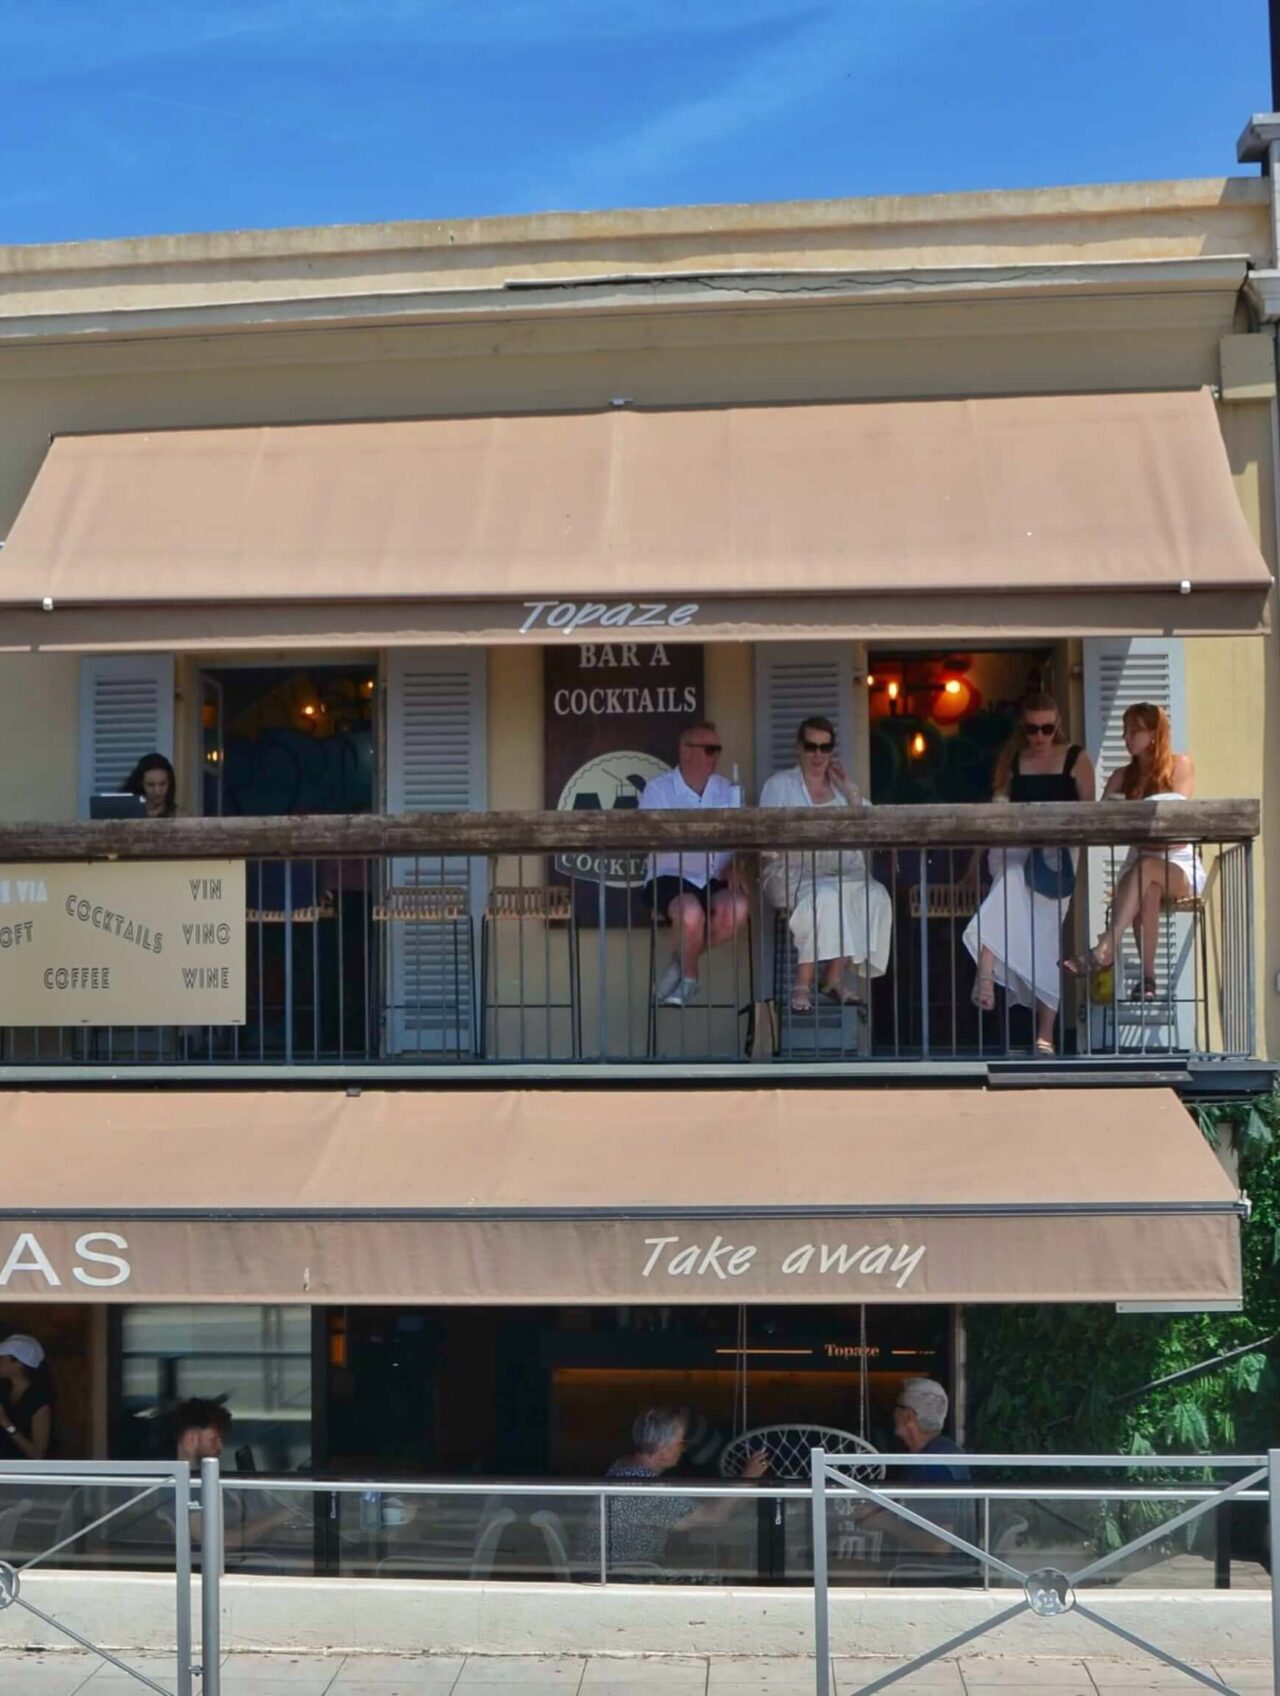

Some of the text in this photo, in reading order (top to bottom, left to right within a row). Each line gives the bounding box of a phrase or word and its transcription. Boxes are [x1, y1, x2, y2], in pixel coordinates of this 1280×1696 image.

[519, 600, 699, 634] Topaze
[579, 642, 671, 668] BAR A
[554, 687, 696, 715] COCKTAILS
[16, 879, 48, 903] VIA
[189, 879, 222, 900] VIN
[65, 895, 163, 954] COCKTAILS
[182, 923, 231, 945] VINO
[44, 967, 110, 989] COFFEE
[182, 967, 230, 989] WINE
[642, 1236, 927, 1288] Take away
[824, 1344, 880, 1360] Topaze
